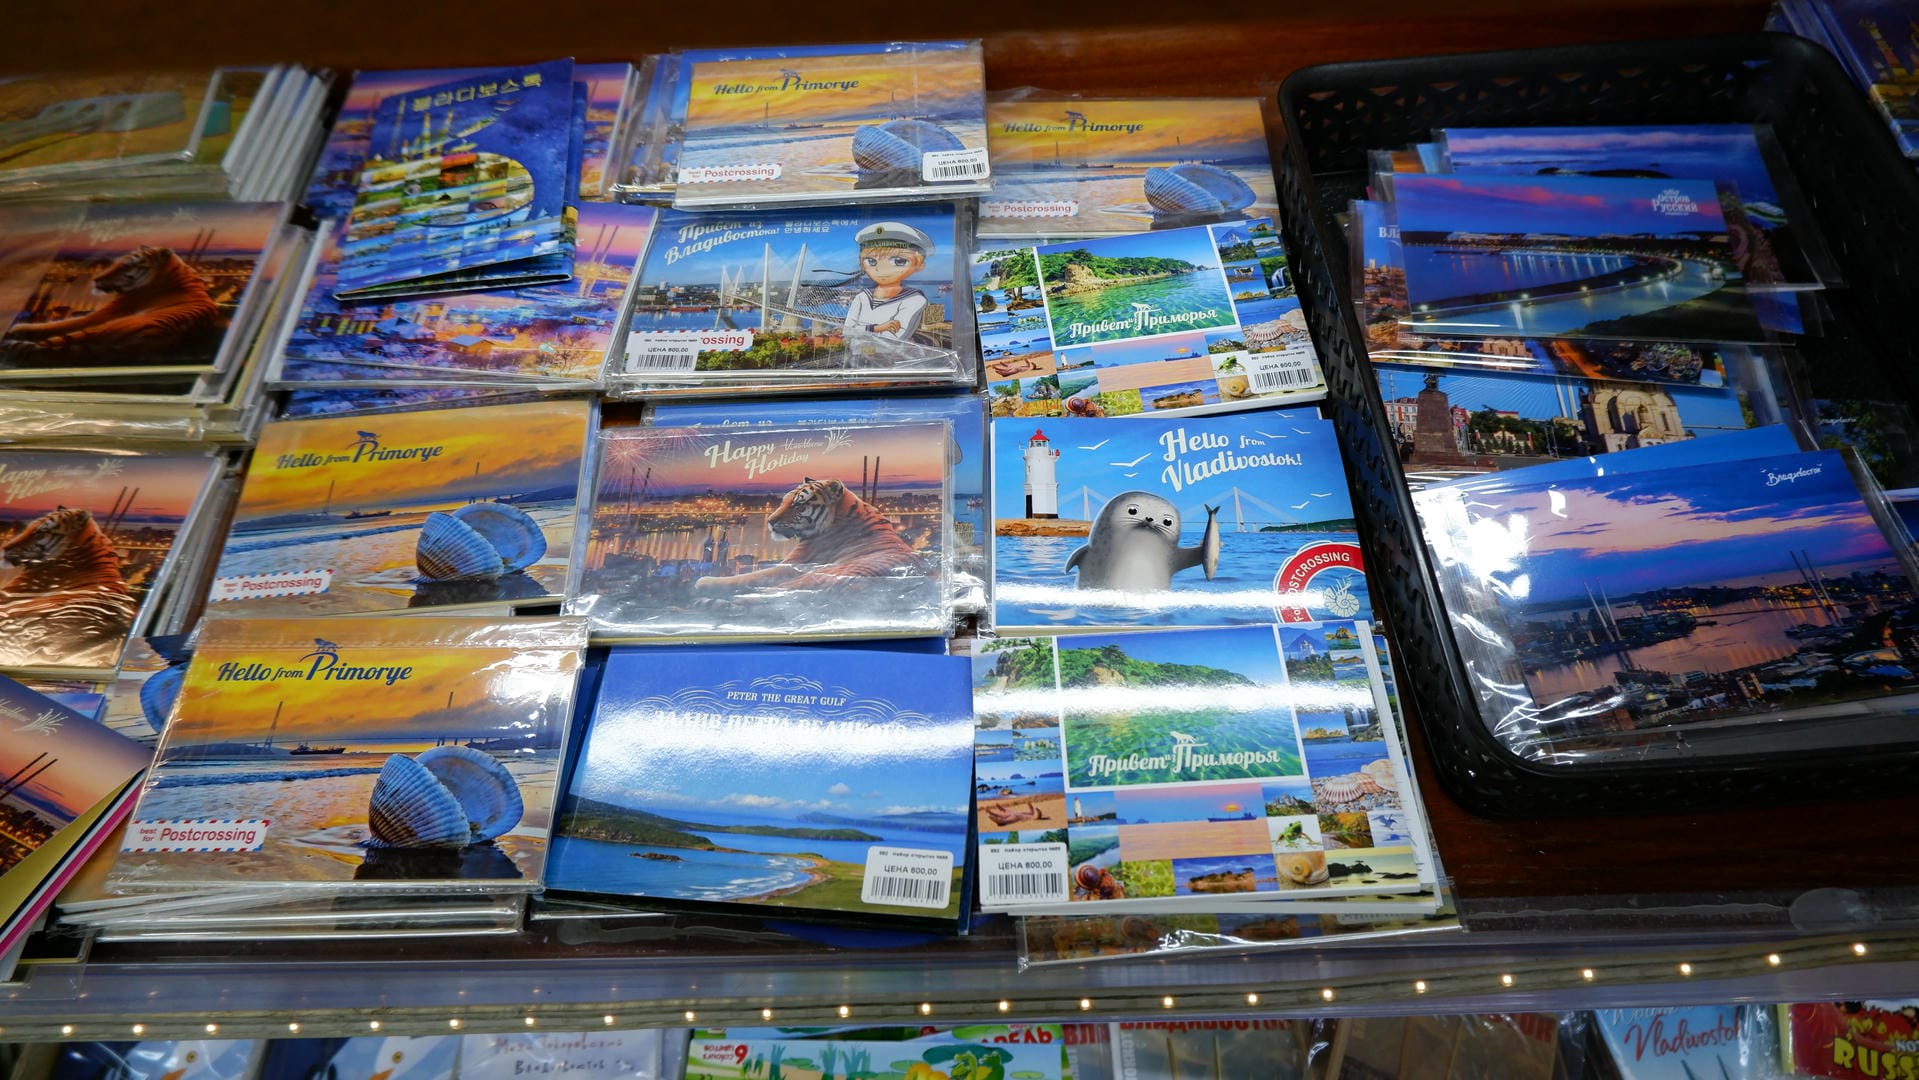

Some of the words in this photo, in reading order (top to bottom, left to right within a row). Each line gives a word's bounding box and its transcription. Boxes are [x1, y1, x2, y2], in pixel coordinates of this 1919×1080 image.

[714, 84, 753, 95] Hello
[756, 85, 778, 93] from
[774, 73, 859, 92] Primorye
[1003, 122, 1042, 133] Hello
[1044, 125, 1066, 133] from
[1061, 118, 1144, 134] Primorye
[704, 168, 774, 178] Postcrossing
[1004, 205, 1072, 213] Postcrossing
[678, 220, 741, 243] Привет
[664, 228, 780, 266] Владивостока!
[1069, 320, 1130, 339] Привет
[1134, 308, 1218, 331] Приморья
[700, 335, 745, 346] ossing
[276, 453, 323, 469] Hello
[323, 455, 350, 466] from
[347, 440, 443, 462] Primorye
[704, 440, 776, 469] Happy
[1159, 428, 1230, 462] Hello
[1239, 435, 1266, 449] from
[744, 453, 809, 479] Holiday
[1161, 450, 1303, 493] Vladivostok!
[241, 578, 322, 591] Postcrossing
[1287, 552, 1350, 595] OSTCROSSING
[217, 662, 271, 681] Hello
[271, 667, 303, 681] from
[299, 652, 413, 686] Primorye
[727, 691, 758, 702] PETER
[762, 693, 781, 703] THE
[784, 695, 817, 705] GREAT
[820, 697, 847, 707] GULF
[1088, 753, 1167, 778] Привет
[1172, 743, 1280, 774] Приморья
[160, 828, 256, 844] Postcrossing
[884, 865, 908, 873] ЦЕНА
[998, 862, 1023, 870] ЦЕНА
[1833, 1037, 1919, 1080] RUSS
